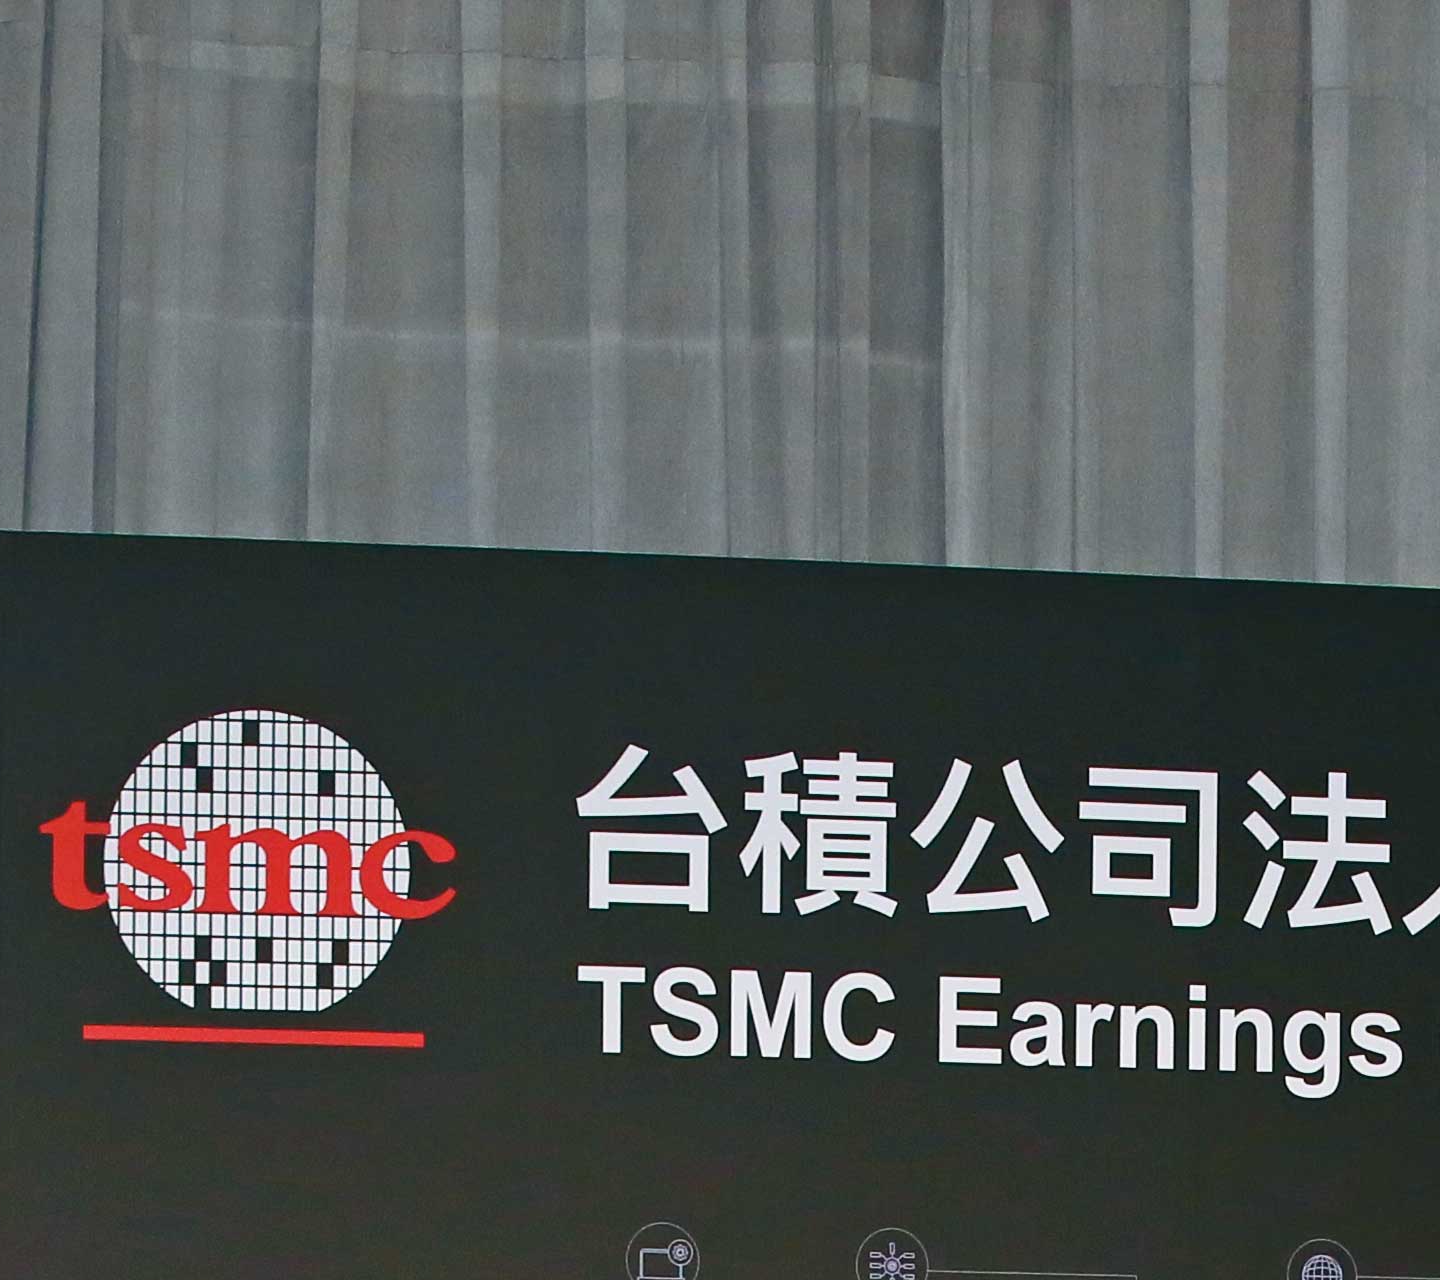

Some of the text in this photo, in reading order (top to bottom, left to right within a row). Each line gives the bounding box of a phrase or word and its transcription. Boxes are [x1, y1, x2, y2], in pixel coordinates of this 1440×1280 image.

[38, 801, 458, 920] tsmc
[577, 964, 896, 1063] TSMC
[938, 975, 1404, 1099] Earnings
